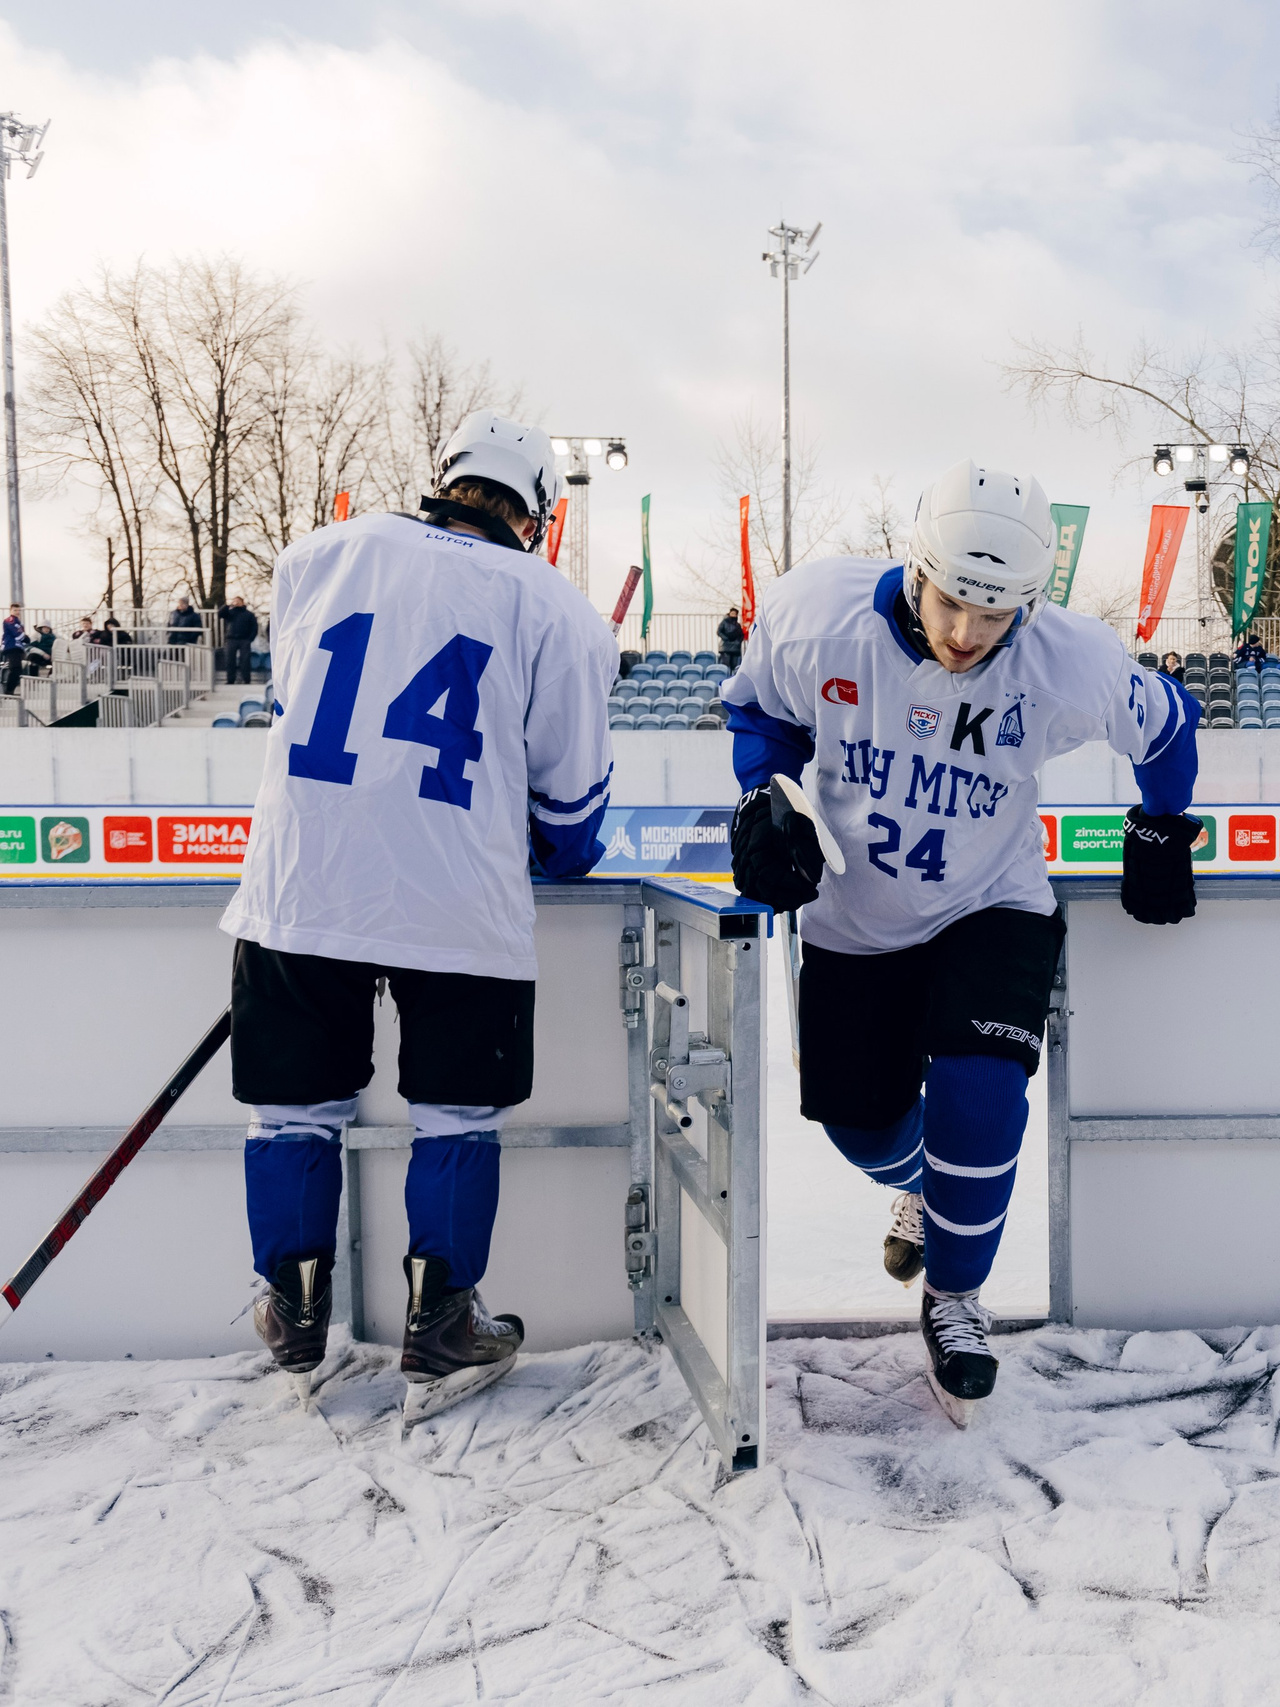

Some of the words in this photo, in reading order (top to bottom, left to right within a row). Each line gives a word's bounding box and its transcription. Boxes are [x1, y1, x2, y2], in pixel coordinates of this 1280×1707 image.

[425, 533, 474, 548] LUTCH
[1051, 524, 1078, 603] ОЛЁД
[1241, 517, 1261, 624] АТОК
[956, 576, 1006, 593] BAUER
[288, 612, 494, 811] 14
[913, 709, 938, 721] МСХЛ
[904, 754, 1008, 819] МГСУ
[173, 824, 248, 842] ЗИМА
[641, 823, 728, 843] МОСКОВСКИЙ
[173, 844, 183, 854] В
[641, 844, 683, 860] СПОРТ
[868, 811, 947, 882] 24
[50, 1106, 163, 1258] JETSPEED
